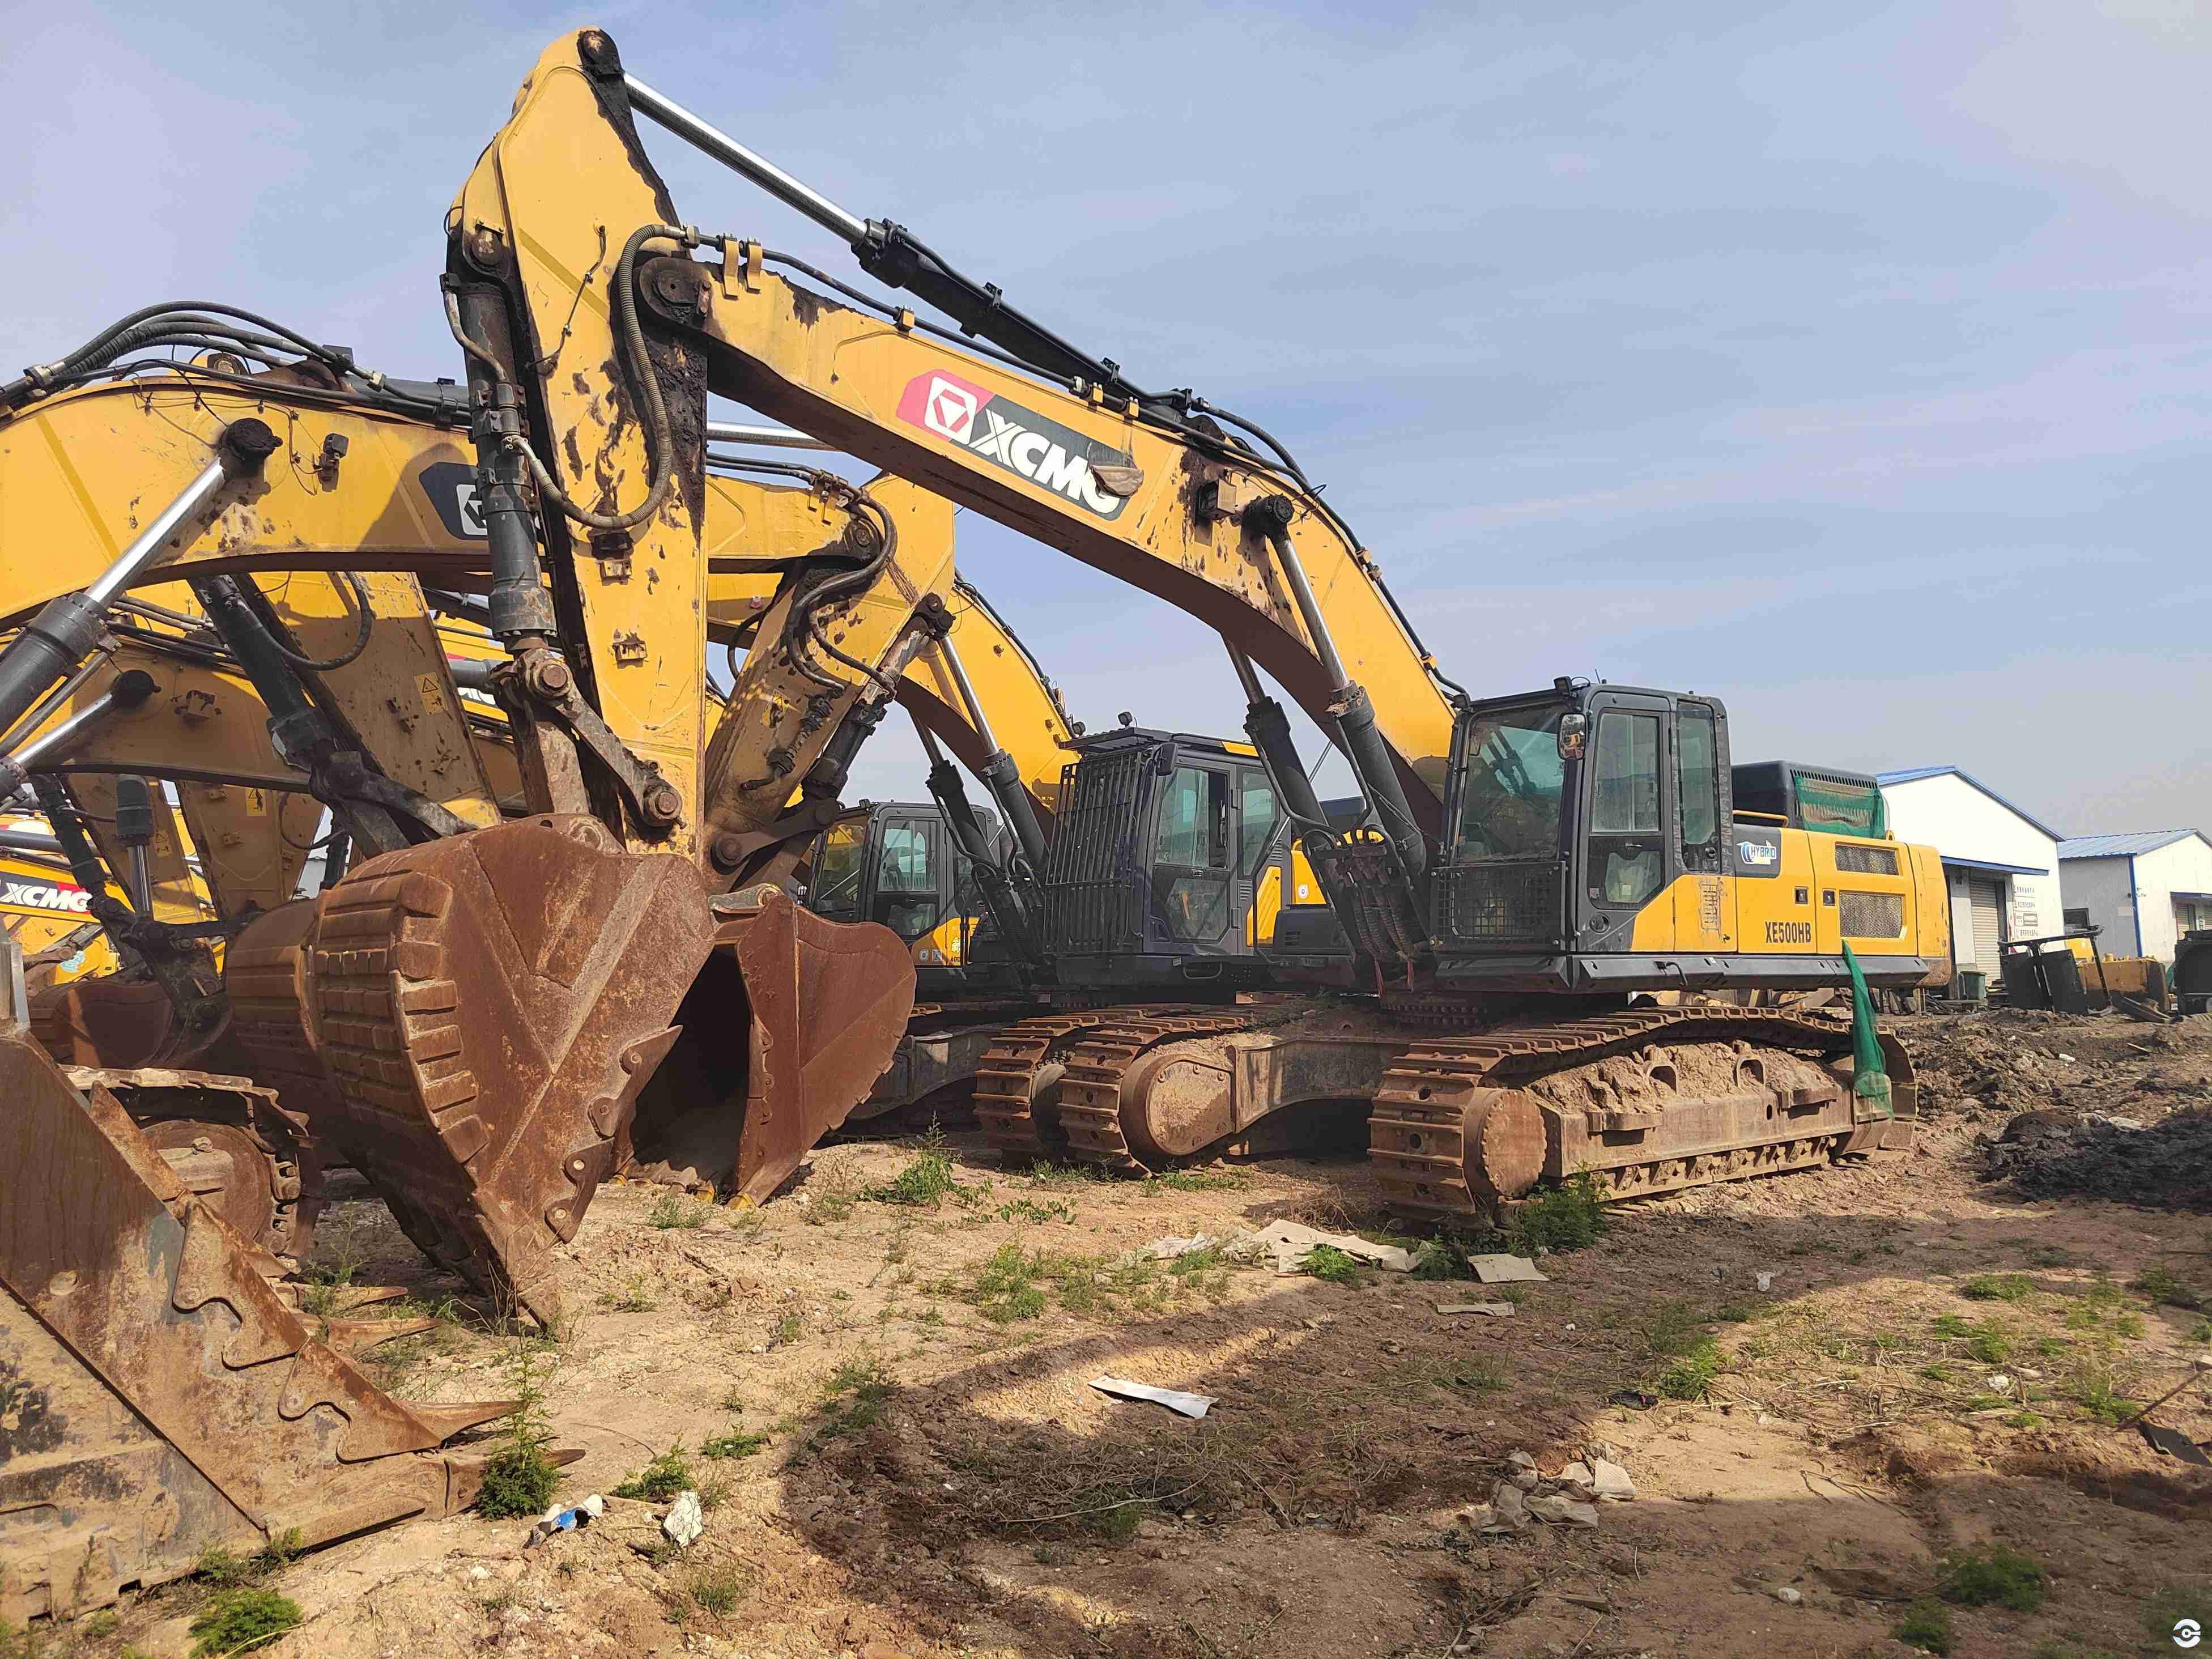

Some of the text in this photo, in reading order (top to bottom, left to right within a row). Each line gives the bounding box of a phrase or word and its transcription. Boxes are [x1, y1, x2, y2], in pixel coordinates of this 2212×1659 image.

[1751, 845, 1776, 857] HYBRID
[0, 883, 93, 912] XCMG
[1765, 921, 1811, 943] XE500HB
